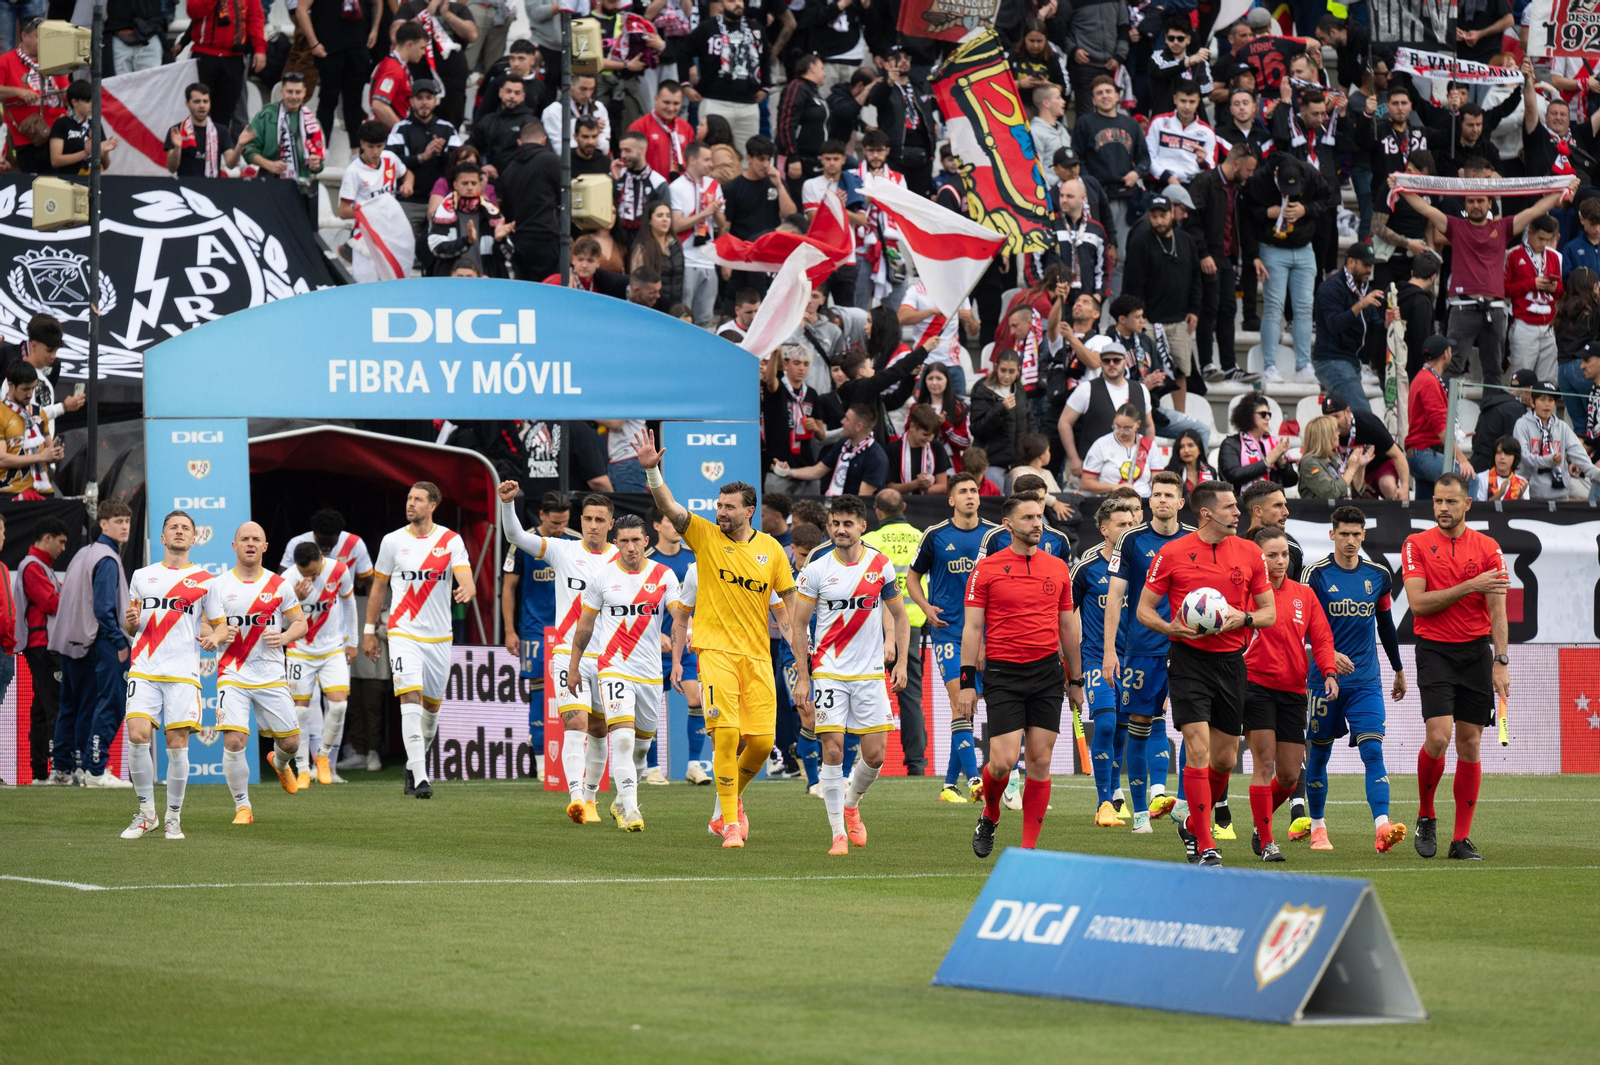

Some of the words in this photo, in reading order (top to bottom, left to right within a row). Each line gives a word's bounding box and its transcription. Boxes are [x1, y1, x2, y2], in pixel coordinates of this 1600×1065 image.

[1247, 51, 1287, 90] 16
[1381, 138, 1399, 154] 19
[372, 308, 537, 344] DIGI
[328, 360, 431, 393] FIBRA
[438, 361, 461, 392] Y
[472, 352, 582, 395] MÓVIL
[171, 431, 223, 443] DIGI
[687, 434, 737, 445] DIGI
[174, 497, 225, 509] DIGI
[688, 499, 718, 510] DI
[892, 545, 908, 554] 124
[948, 557, 977, 573] wib
[402, 570, 447, 581] DIGI
[533, 567, 555, 582] wib
[719, 568, 769, 594] DIGI
[142, 597, 194, 615] DIGI
[610, 603, 660, 617] DIGI
[827, 597, 879, 611] DIGI
[1328, 598, 1375, 617] wiber
[226, 614, 276, 627] DIGI
[525, 640, 540, 658] 17
[935, 643, 955, 662] 28
[288, 663, 302, 680] 18
[559, 670, 569, 688] 8
[1086, 668, 1102, 687] 12
[1122, 667, 1145, 690] 23
[219, 690, 226, 709] 7
[606, 681, 625, 700] 12
[709, 685, 714, 705] 1
[814, 688, 835, 709] 23
[1311, 695, 1328, 717] 15
[976, 899, 1080, 946] DIGI
[1084, 915, 1183, 948] PATROCINADOR
[1175, 923, 1246, 954] PRINCIPAL
